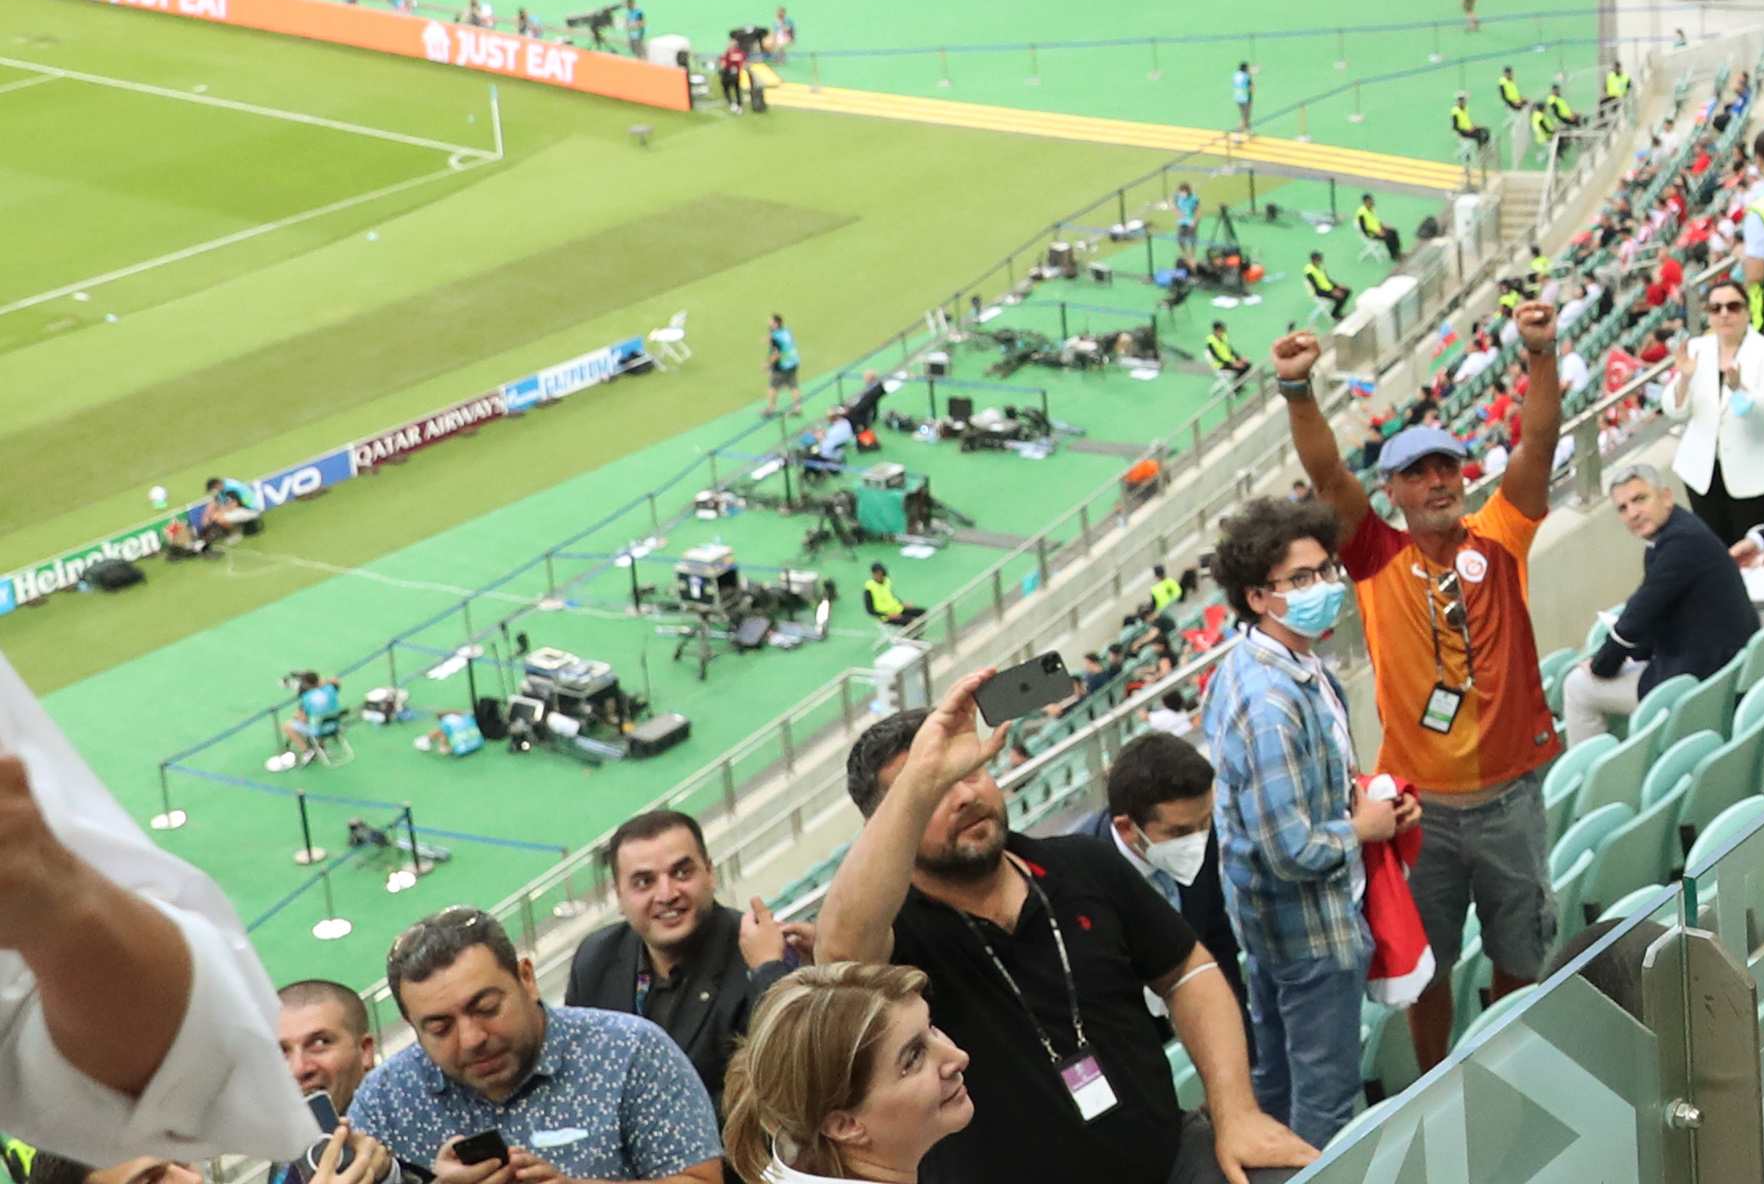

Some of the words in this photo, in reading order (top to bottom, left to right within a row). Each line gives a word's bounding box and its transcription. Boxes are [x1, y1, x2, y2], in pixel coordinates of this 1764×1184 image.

[456, 29, 520, 67] JUST
[525, 43, 579, 84] EAT
[355, 424, 422, 467] QATAR
[423, 395, 506, 441] AIRWAYS
